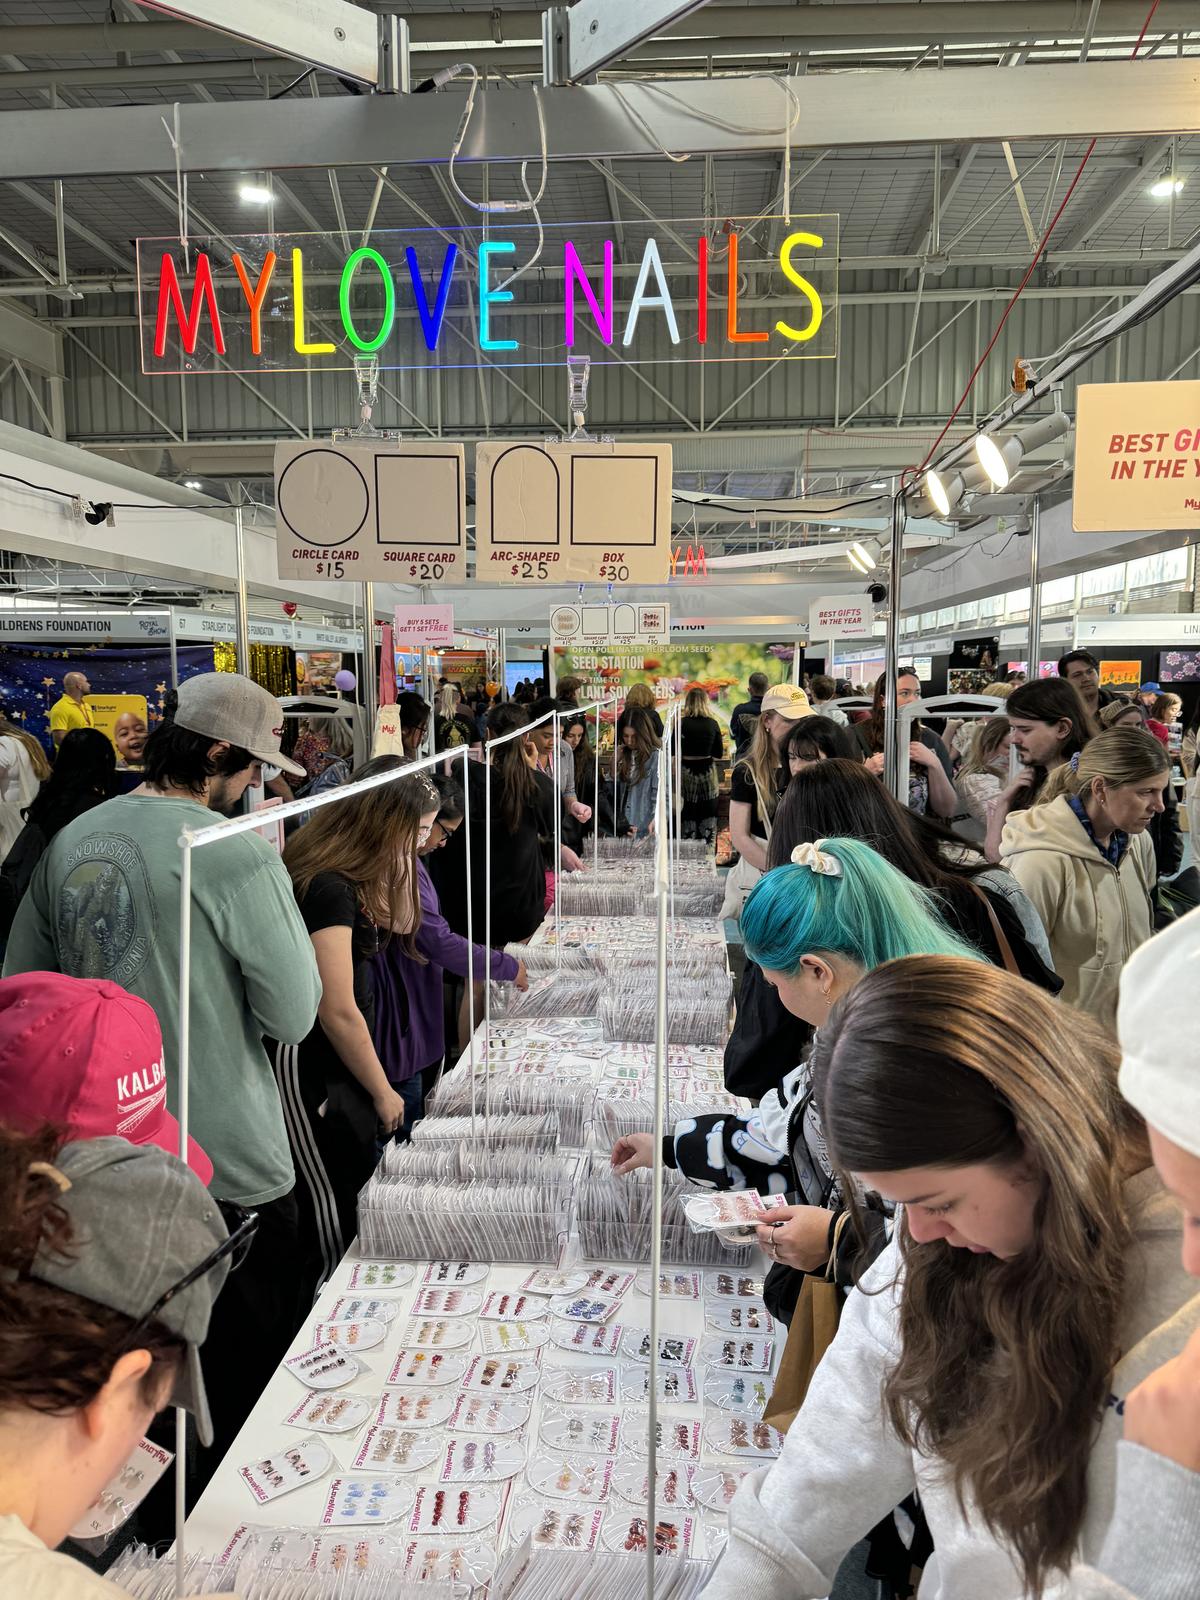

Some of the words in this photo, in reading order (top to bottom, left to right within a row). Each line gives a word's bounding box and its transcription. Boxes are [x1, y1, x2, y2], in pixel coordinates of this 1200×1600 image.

[563, 232, 825, 347] NAILS
[1108, 433, 1170, 454] BEST
[1110, 460, 1136, 480] IN
[1143, 458, 1188, 479] THE
[292, 549, 329, 560] CIRCLE
[331, 550, 360, 561] CARD
[383, 552, 425, 563] SQUARE
[427, 553, 456, 563] CARD
[490, 551, 560, 562] ARC-SHAPED
[602, 553, 625, 563] BOX
[838, 608, 861, 616] GIFTS
[46, 620, 111, 632] FOUNDATION
[1091, 626, 1096, 635] 7
[1184, 624, 1200, 634] LIN
[572, 656, 599, 669] SEED
[602, 656, 644, 670] STATION
[579, 686, 606, 698] LANT
[66, 840, 138, 873] SNOWSHOE
[356, 1425, 379, 1467] MyLoveNAILS
[323, 1479, 342, 1524] MyLoveNAILS
[410, 1487, 427, 1532] MyLoveNAILS
